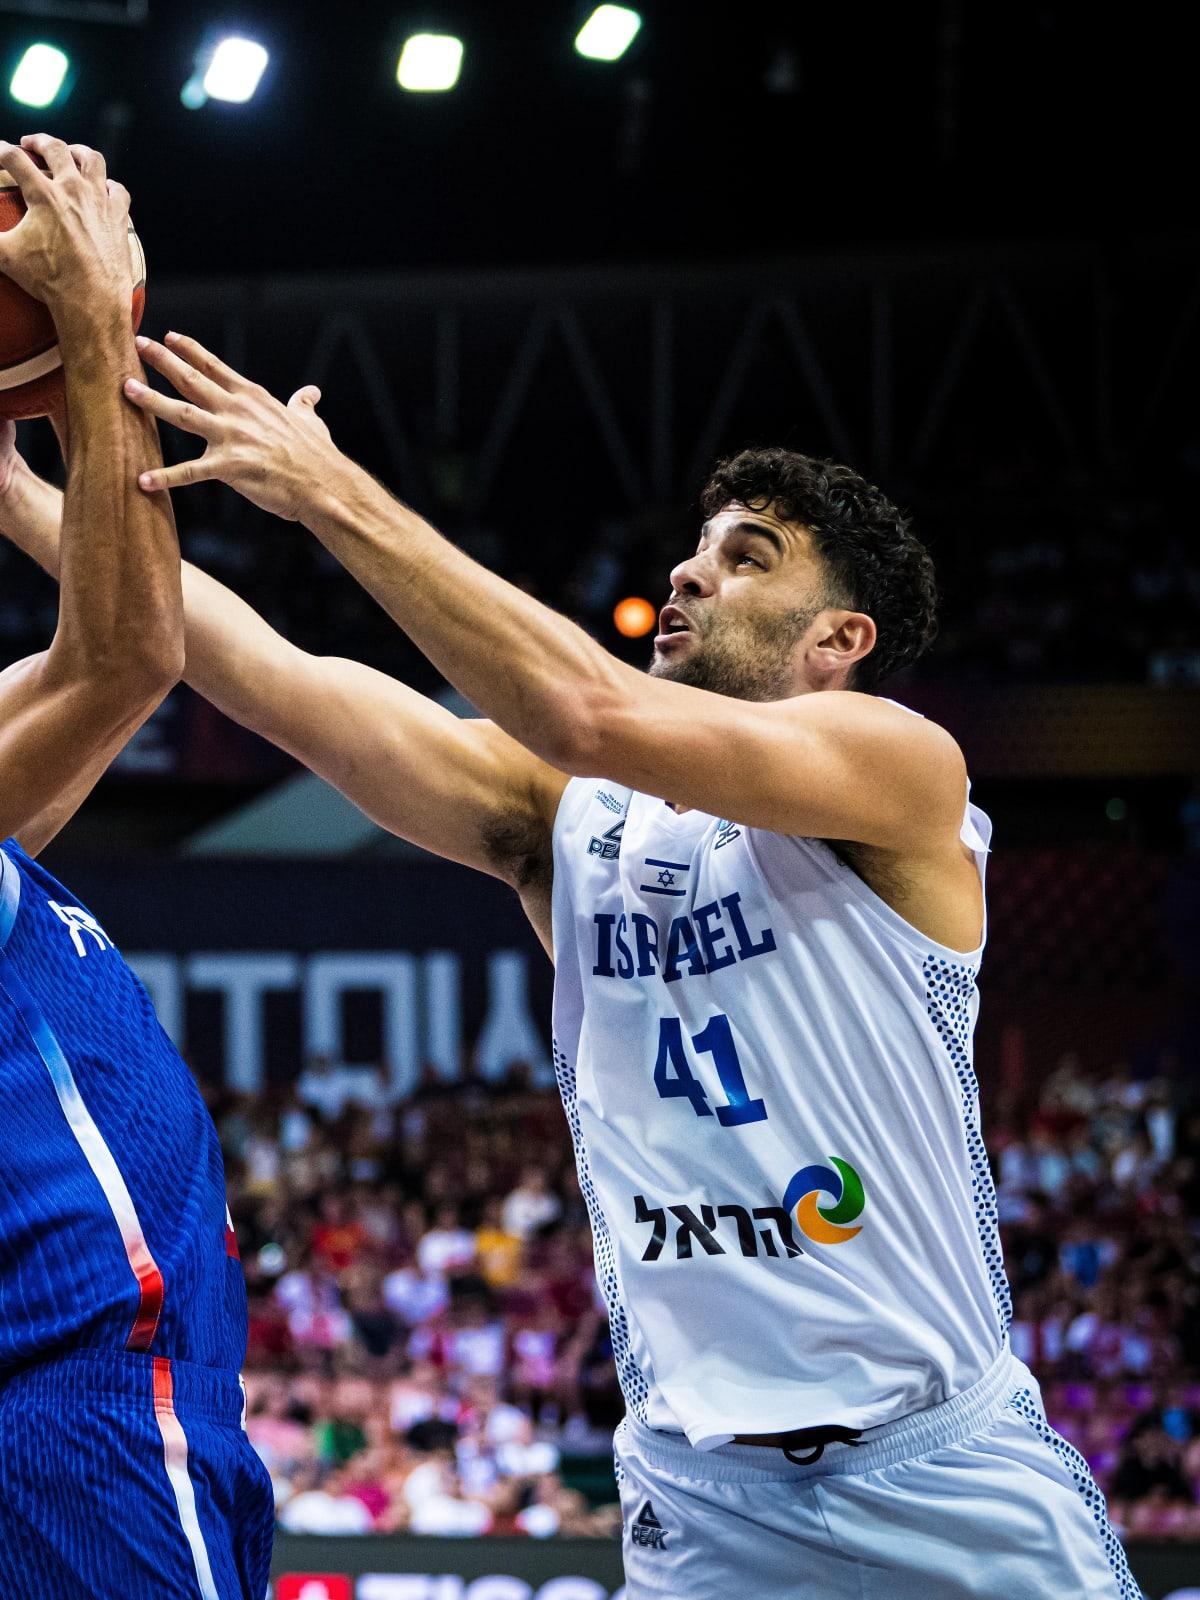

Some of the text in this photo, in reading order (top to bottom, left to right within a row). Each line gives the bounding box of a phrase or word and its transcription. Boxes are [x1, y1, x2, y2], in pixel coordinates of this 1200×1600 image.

[714, 823, 741, 850] 25
[593, 892, 777, 983] ISRAEL
[654, 1014, 768, 1127] 41
[634, 1194, 804, 1261] הראל
[631, 1524, 669, 1550] PEAK
